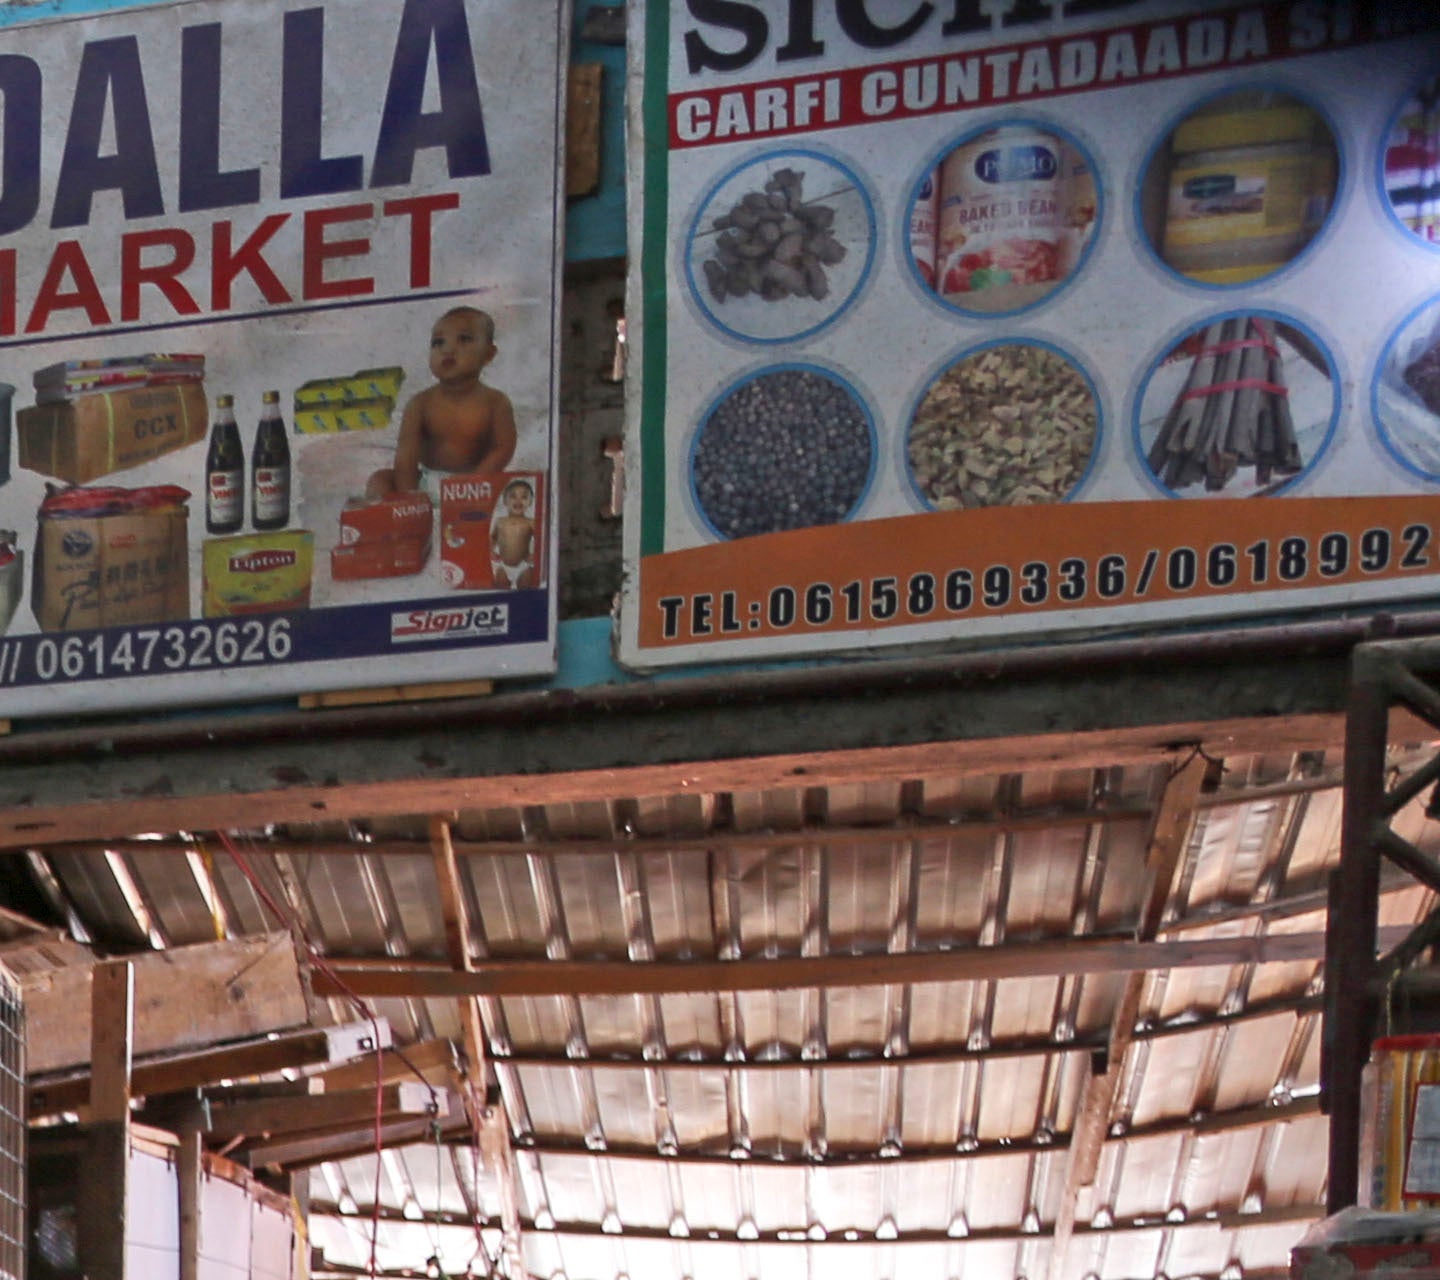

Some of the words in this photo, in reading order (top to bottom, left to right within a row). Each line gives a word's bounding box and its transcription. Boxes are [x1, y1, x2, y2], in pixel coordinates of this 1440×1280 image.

[676, 80, 841, 142] CARFI
[859, 8, 1271, 120] CUNTADAADA
[443, 482, 492, 500] NUNA
[392, 504, 430, 518] NUNA
[232, 551, 294, 570] Lipton
[408, 606, 505, 633] Signjet
[34, 617, 293, 680] 0614732626
